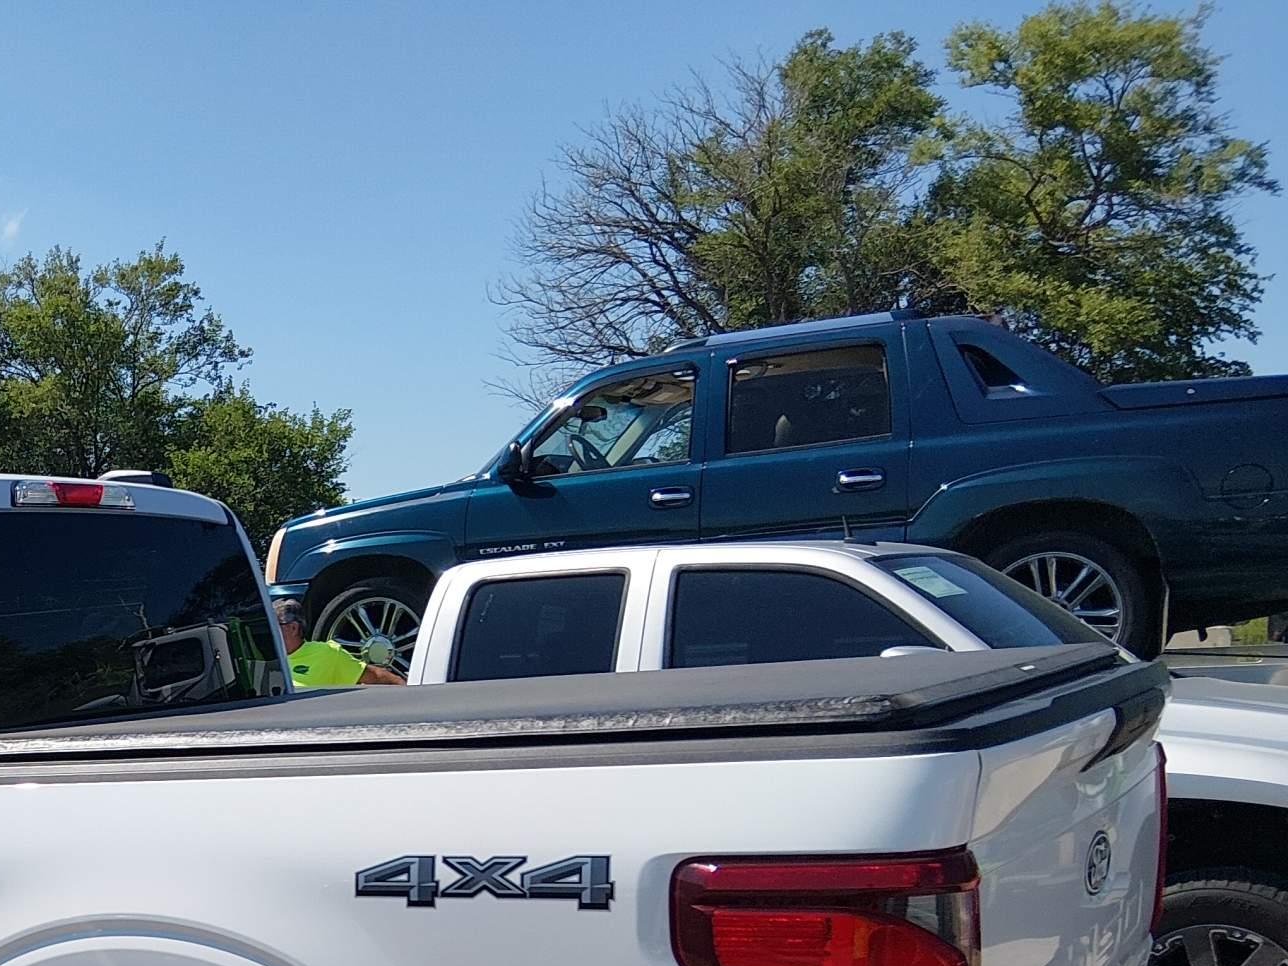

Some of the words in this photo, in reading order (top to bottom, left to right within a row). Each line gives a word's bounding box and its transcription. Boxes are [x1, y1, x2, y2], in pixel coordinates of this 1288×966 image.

[479, 543, 537, 555] ESCALADE
[543, 540, 566, 550] EXT
[355, 854, 615, 911] 4X4
